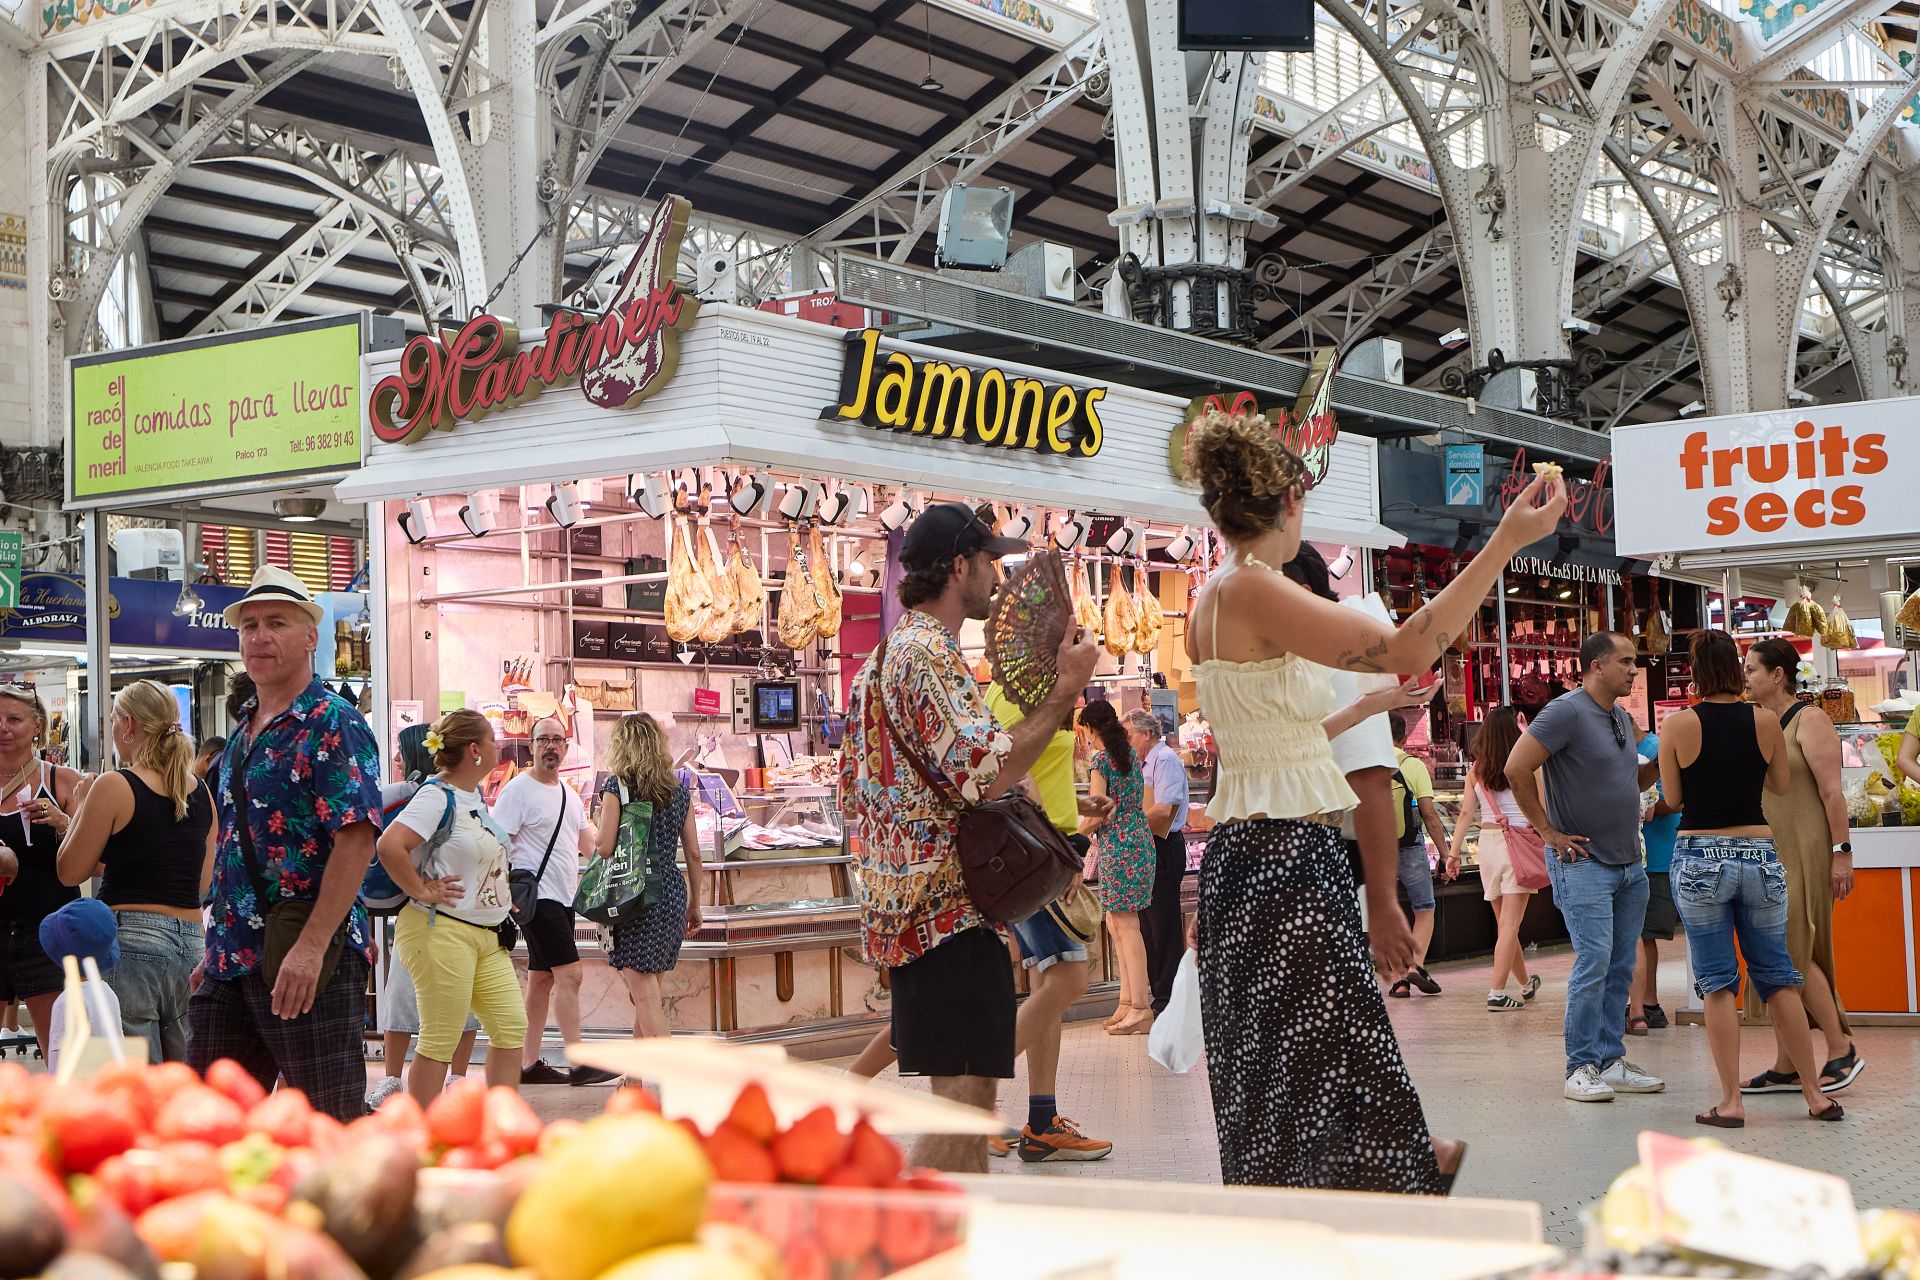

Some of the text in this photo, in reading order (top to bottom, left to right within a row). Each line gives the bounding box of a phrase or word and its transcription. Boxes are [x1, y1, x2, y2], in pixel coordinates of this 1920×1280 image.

[720, 328, 740, 340] PUESTOS
[740, 332, 750, 342] DEL
[838, 328, 1107, 457] Jamones
[87, 402, 121, 426] racó
[134, 380, 353, 437] comidas para llevar
[305, 436, 316, 451] 96
[317, 434, 332, 449] 382
[333, 433, 342, 447] 91
[343, 431, 354, 446] 43
[134, 456, 213, 473] VALENCIA FOOD TAKE AWAY
[235, 447, 268, 461] Palco 173
[1680, 421, 1888, 489] fruits
[1706, 485, 1866, 536] secs
[1510, 556, 1623, 586] LOS PLACERES DE LA MESA
[22, 614, 78, 626] ALBORAYA
